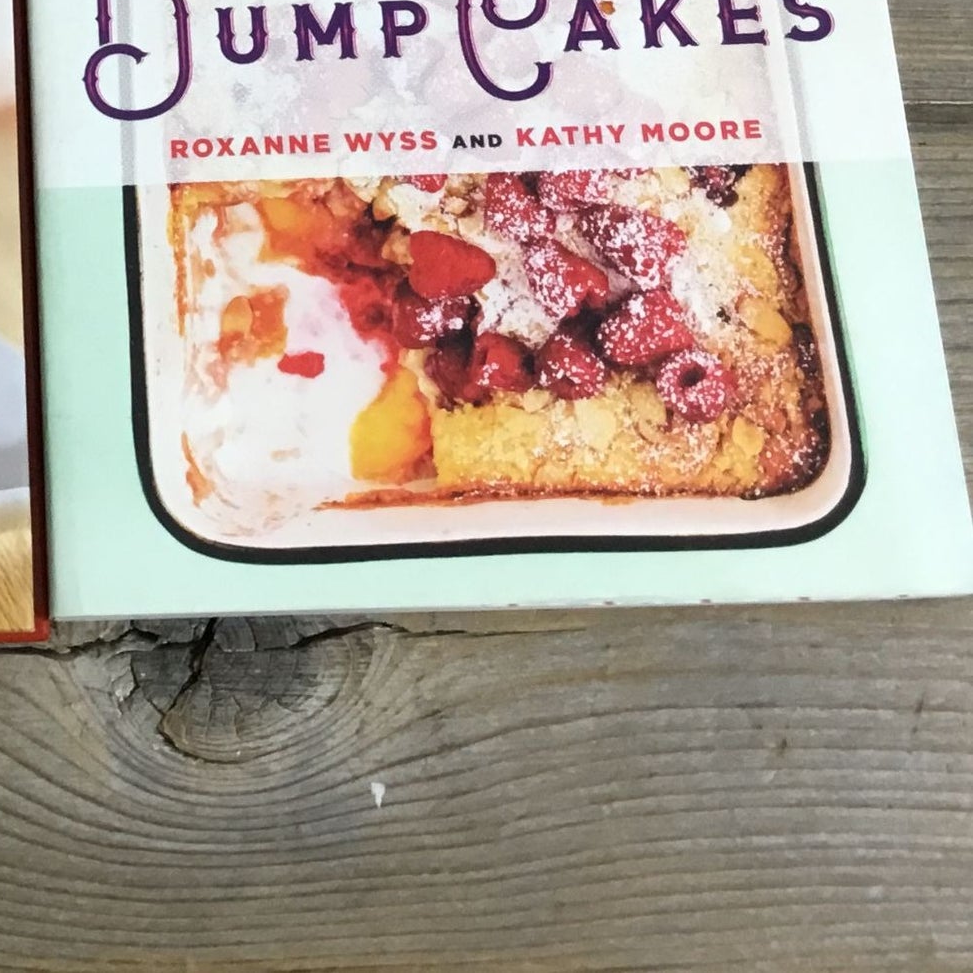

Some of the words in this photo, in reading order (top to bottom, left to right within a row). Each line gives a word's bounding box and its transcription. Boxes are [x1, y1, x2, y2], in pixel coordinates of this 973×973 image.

[169, 133, 332, 159] ROXANNE
[344, 130, 439, 153] WYSS
[452, 133, 503, 149] AND
[515, 123, 626, 148] KATHY
[641, 119, 764, 143] MOORE
